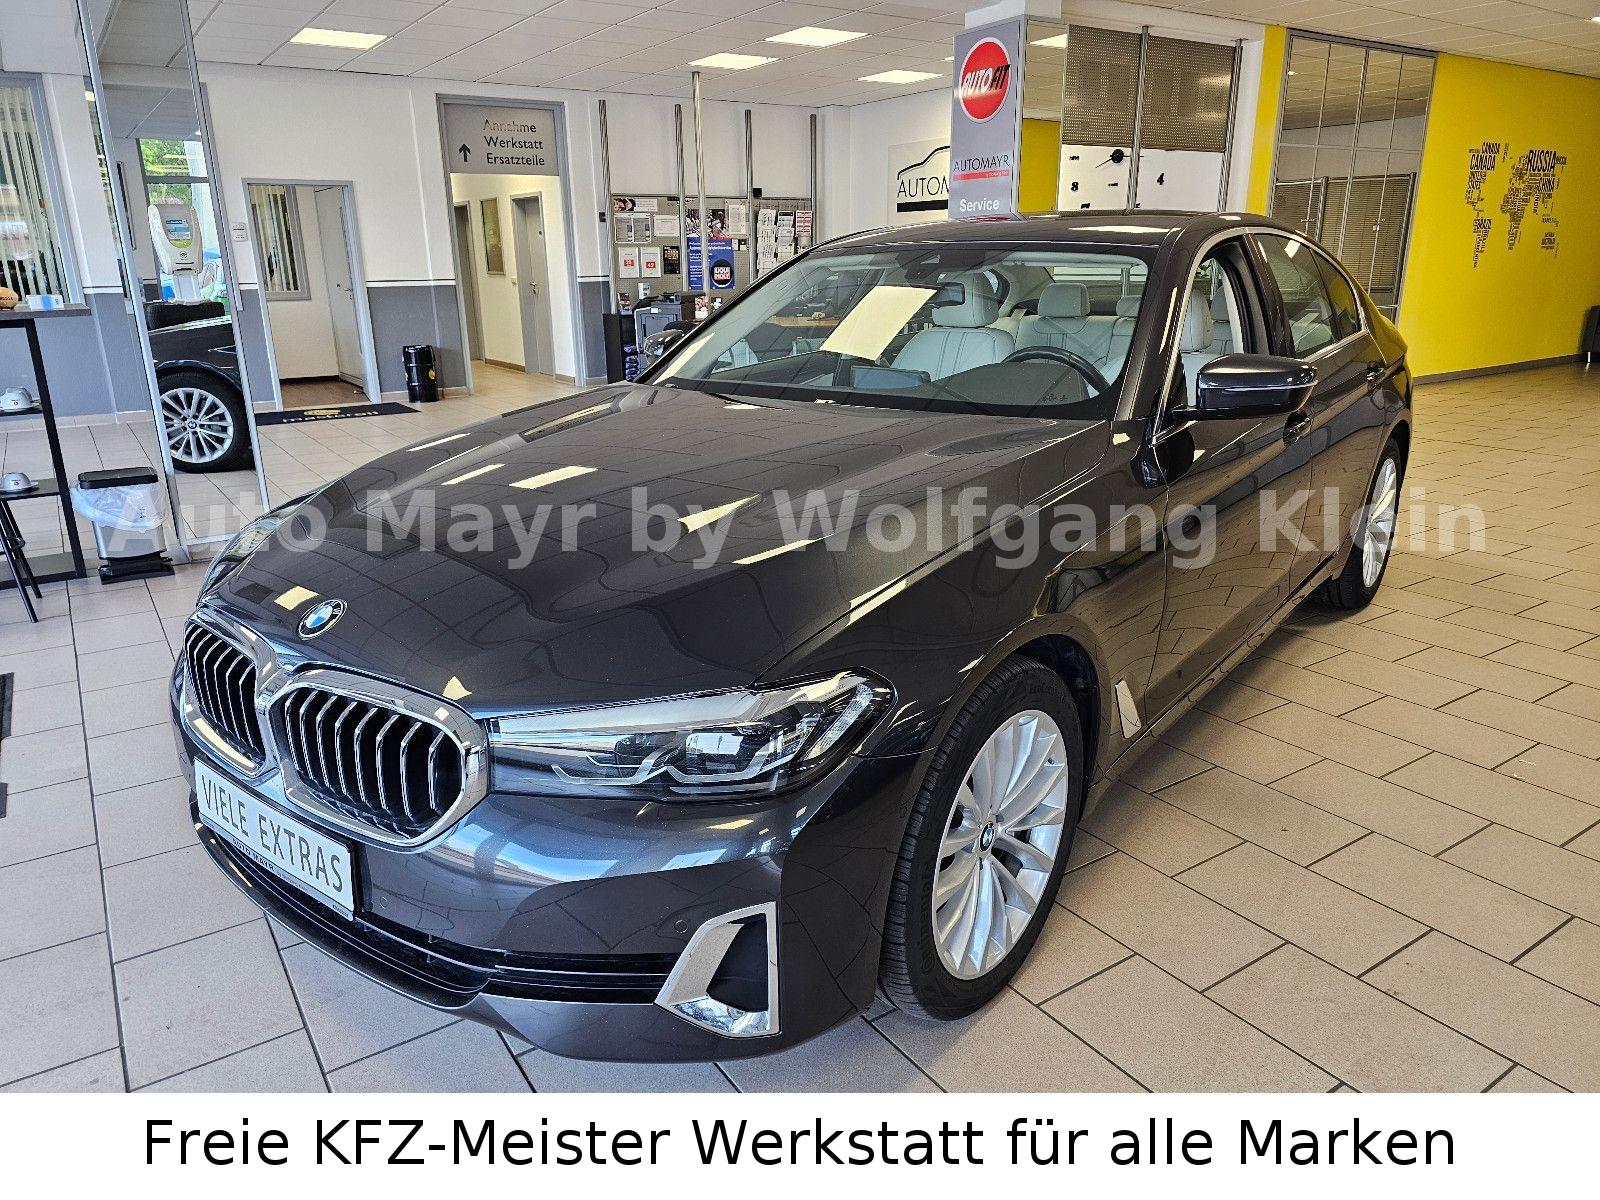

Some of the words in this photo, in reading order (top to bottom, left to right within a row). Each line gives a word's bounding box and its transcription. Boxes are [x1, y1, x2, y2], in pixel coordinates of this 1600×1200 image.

[484, 135, 544, 150] Werkstatt
[486, 152, 545, 166] Ersatzteile
[953, 154, 1010, 172] AUTOMAYR
[1470, 154, 1496, 171] CANADA
[1527, 149, 1556, 172] RUSSIA
[1156, 172, 1165, 186] 4
[1070, 182, 1079, 192] 8
[959, 198, 1000, 212] Service
[201, 774, 250, 838] VIELE
[258, 813, 344, 893] EXTRAS
